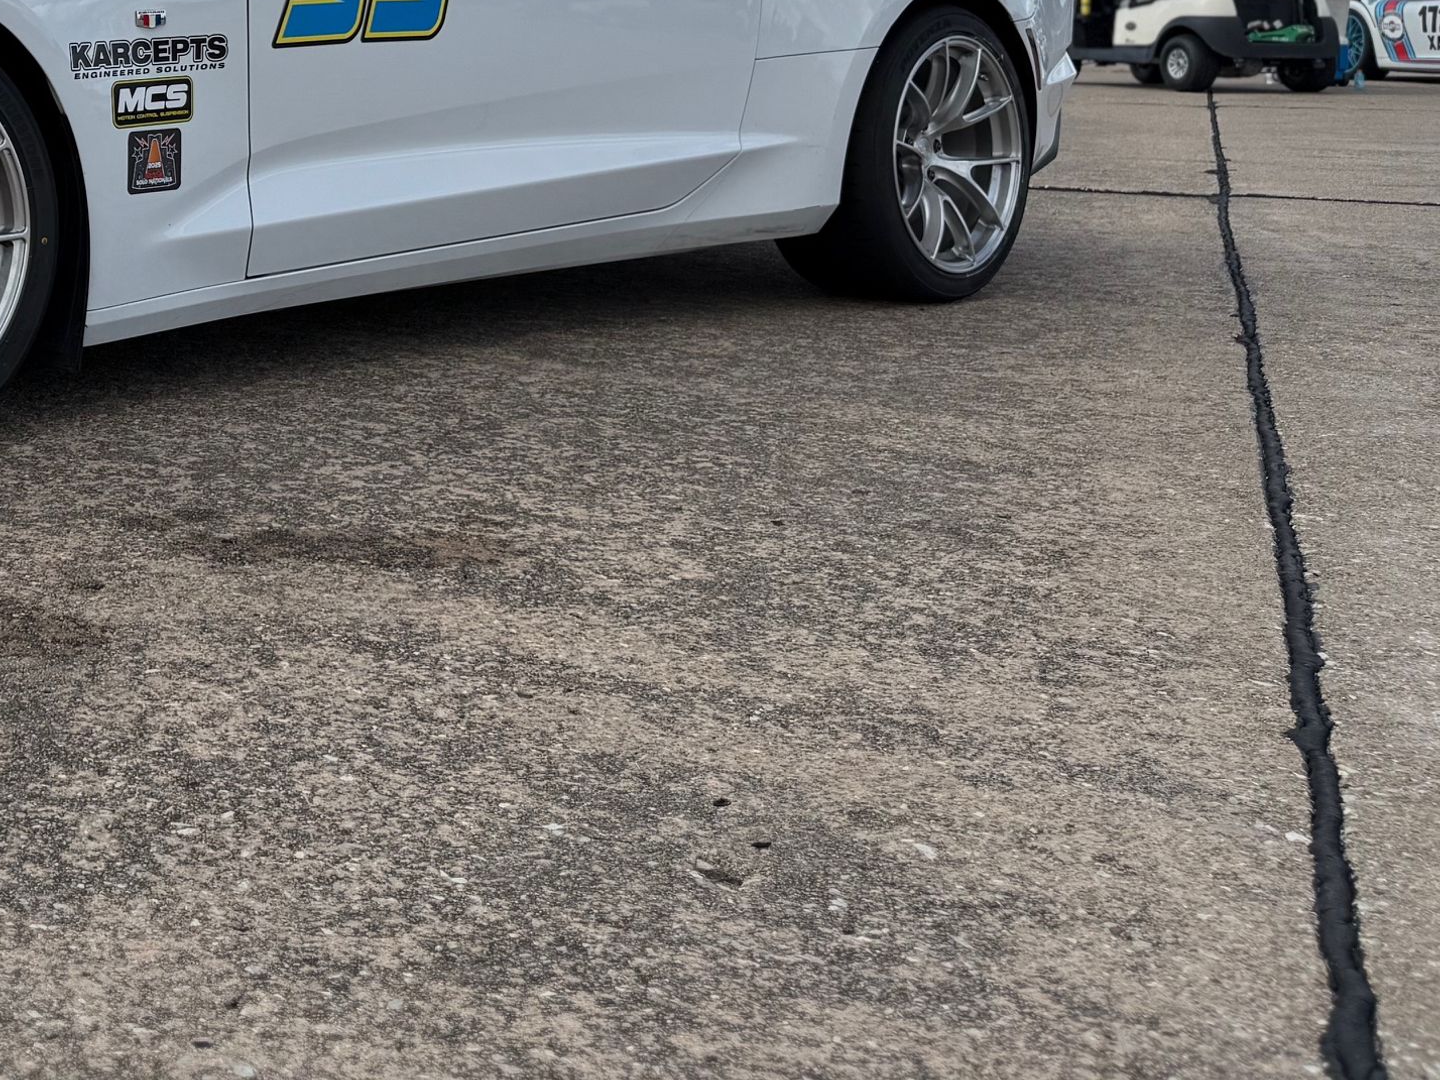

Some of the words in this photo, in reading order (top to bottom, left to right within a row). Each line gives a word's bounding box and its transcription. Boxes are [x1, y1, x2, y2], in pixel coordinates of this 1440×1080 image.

[1418, 5, 1440, 33] 17
[69, 34, 228, 71] KARCEPTS
[74, 67, 150, 80] ENGINEERED
[156, 62, 225, 73] SOLUTIONS
[117, 83, 189, 113] MCS
